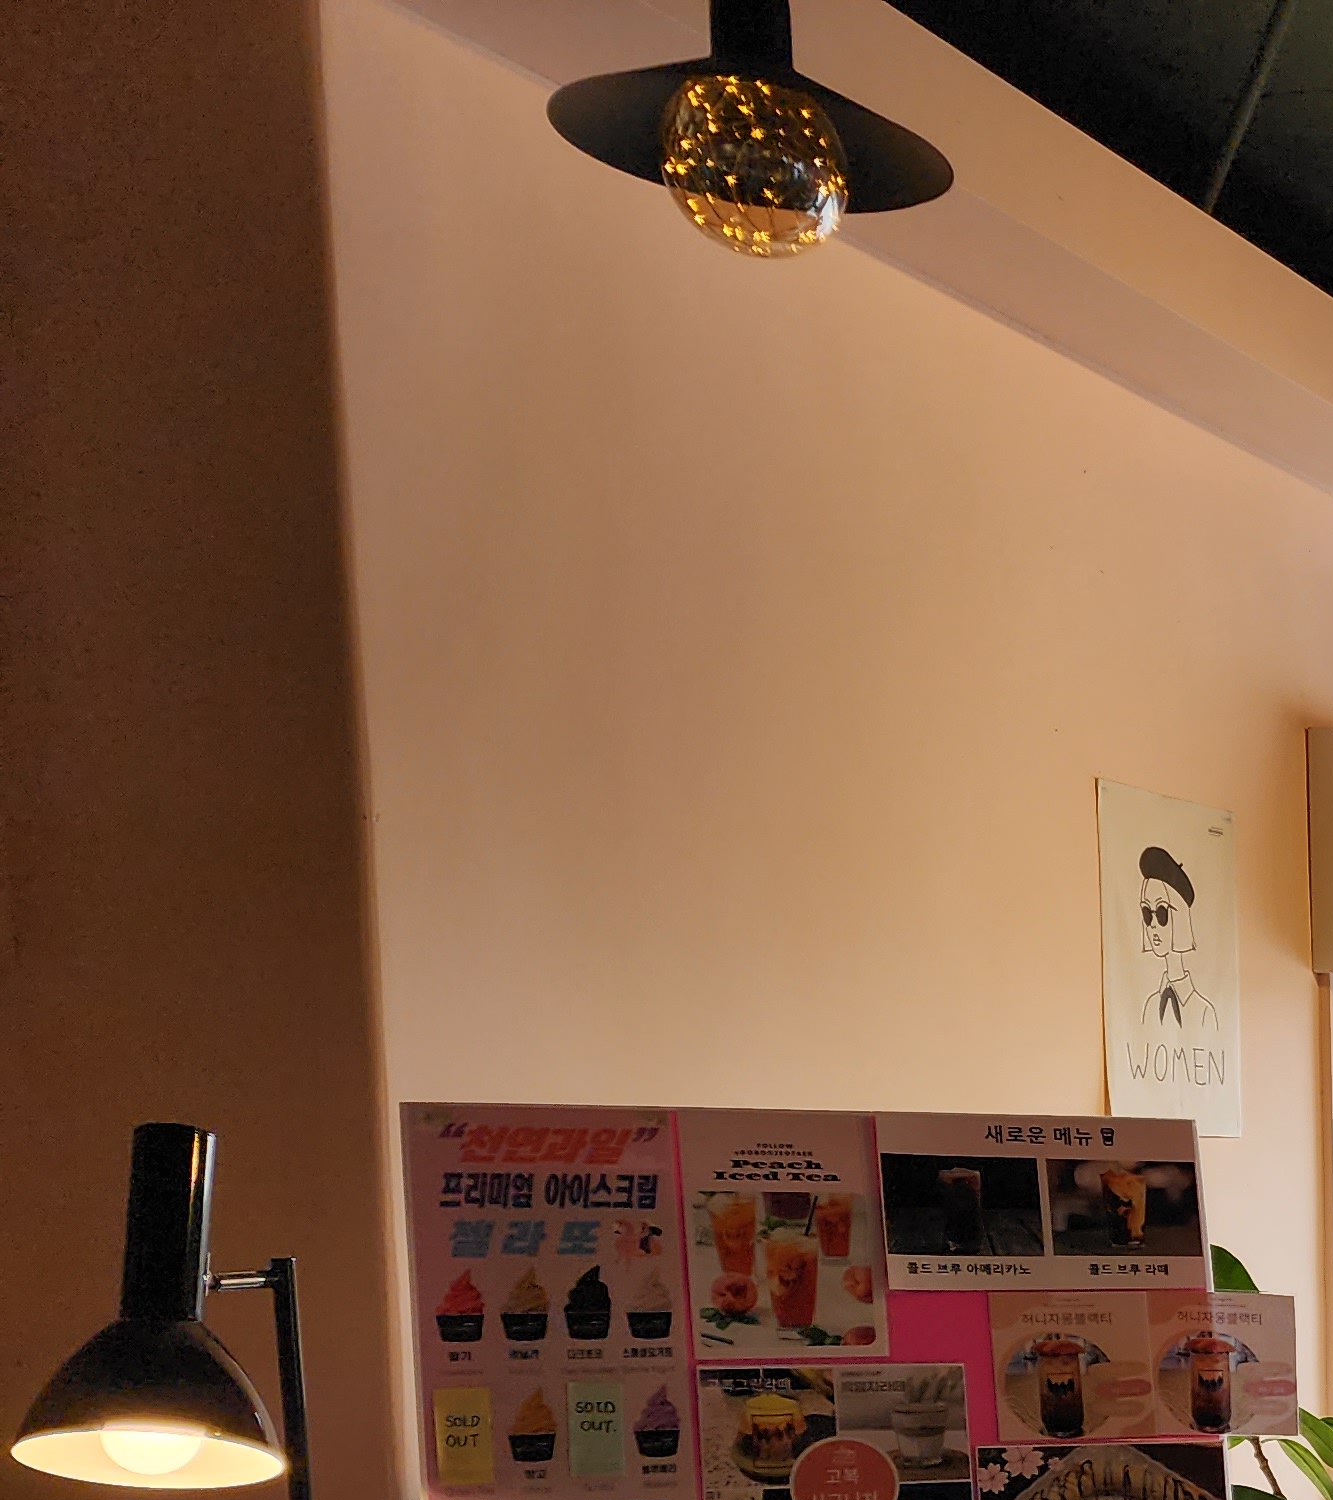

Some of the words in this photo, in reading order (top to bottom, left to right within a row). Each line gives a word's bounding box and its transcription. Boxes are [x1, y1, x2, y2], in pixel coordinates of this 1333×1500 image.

[1126, 1041, 1225, 1086] WOMEN
[985, 1124, 1047, 1145] 새로운
[1053, 1126, 1093, 1147] 메뉴
[730, 1159, 823, 1170] Peach
[713, 1170, 781, 1181] Iced
[786, 1171, 841, 1182] Tea
[439, 1172, 534, 1209] 프리미엄
[544, 1172, 658, 1209] 아이스크림
[907, 1262, 932, 1275] 콜드
[938, 1263, 962, 1275] 브루
[967, 1263, 1032, 1276] 아메리카노
[1088, 1263, 1113, 1276] 콜드
[574, 1401, 616, 1414] SOLD
[444, 1414, 481, 1428] SOLD
[444, 1433, 480, 1448] OUT
[825, 1468, 859, 1484] 고복
